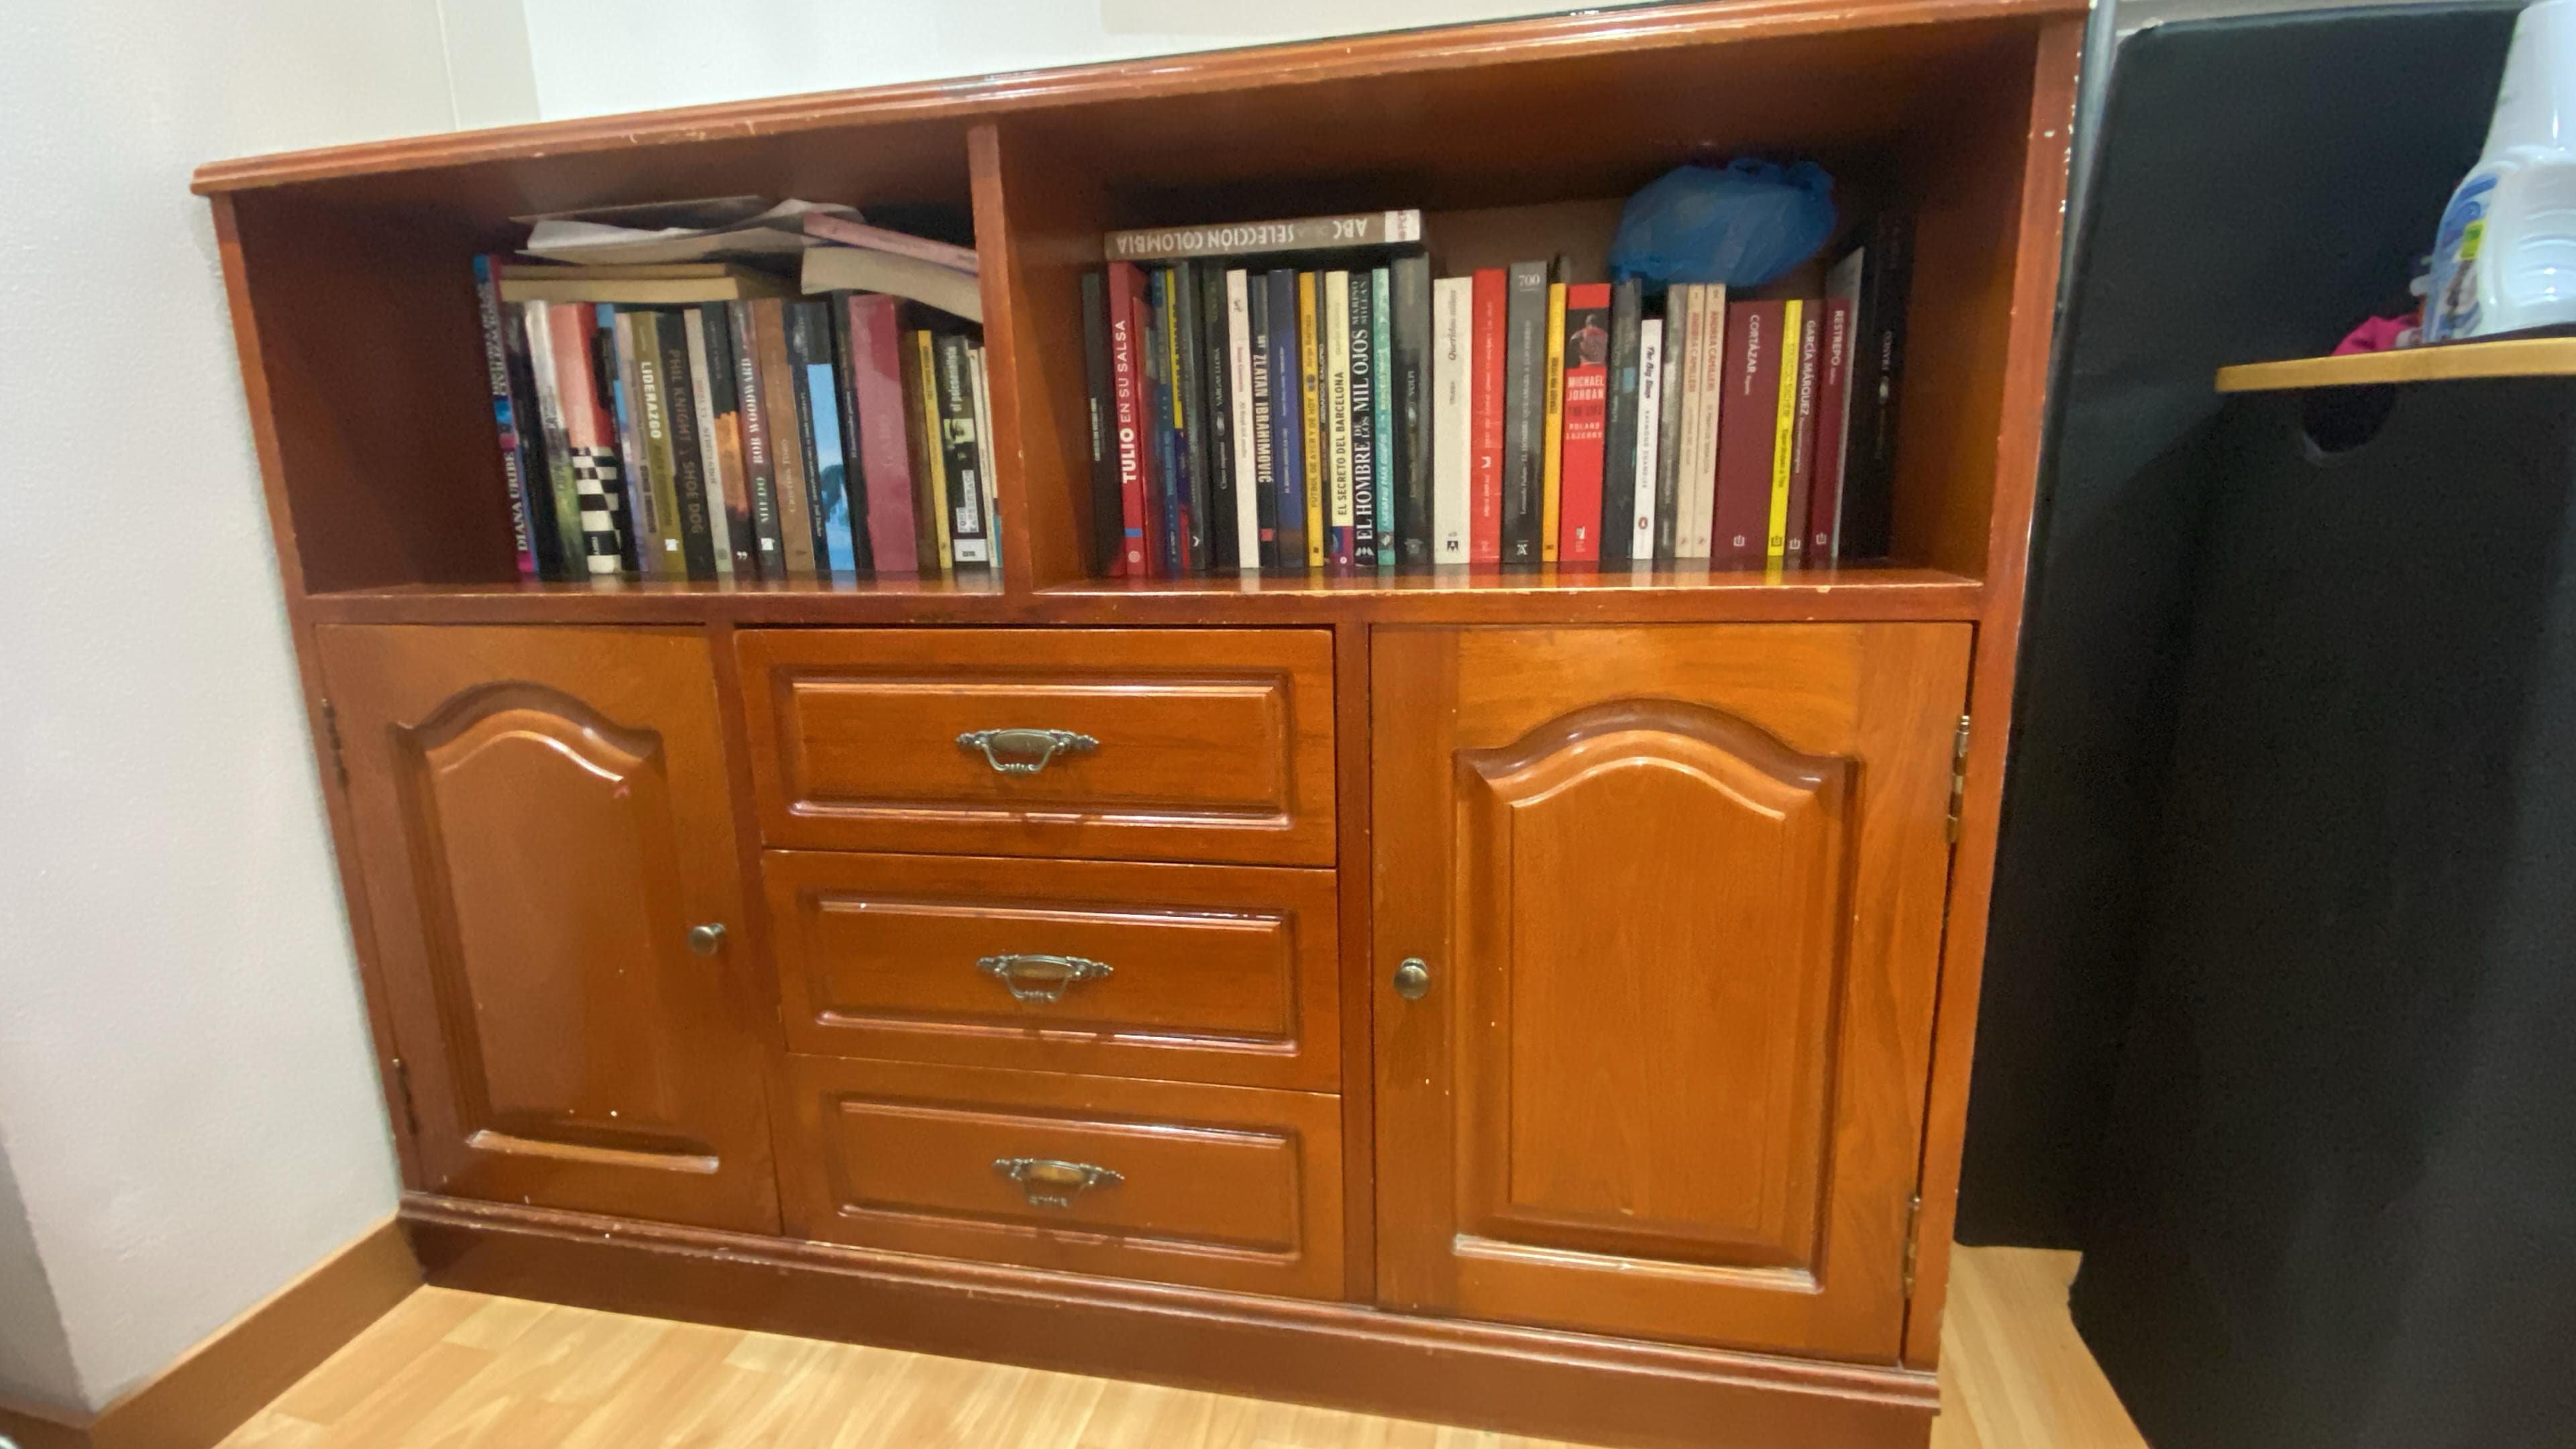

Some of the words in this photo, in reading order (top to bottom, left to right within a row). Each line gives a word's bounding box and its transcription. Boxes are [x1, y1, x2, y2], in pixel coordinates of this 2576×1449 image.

[1116, 231, 1203, 254] COLOMBIA
[1208, 223, 1294, 251] SELECCIÓN
[1333, 218, 1367, 239] ABC
[1519, 274, 1540, 286] 700
[1116, 320, 1128, 372] SALSA
[1690, 311, 1699, 347] ANDREA
[1709, 311, 1719, 346] ANDREA
[1747, 314, 1761, 373] CORTÁZAR
[1803, 320, 1816, 362] GARCÍA
[1830, 309, 1845, 366] RESTREPO
[668, 349, 684, 383] PHIL
[1352, 329, 1369, 375] OJOS
[1644, 362, 1654, 378] Big
[1647, 346, 1655, 361] The
[1688, 349, 1699, 393] CAMILLERI
[1706, 347, 1717, 392] CAMILLERI
[946, 346, 963, 401] psicoanalista
[1118, 378, 1130, 398] SU
[1252, 354, 1269, 397] ZLATAN
[1568, 374, 1605, 388] MICHAEL
[1799, 362, 1815, 416] MÁRQUEZ
[641, 361, 662, 439] LIDERAZGO
[674, 386, 692, 441] KNIGHT
[741, 358, 761, 433] WOODWARD
[1120, 403, 1130, 423] EN
[1334, 372, 1345, 433] BARCELONA
[1352, 378, 1370, 412] MIL
[1567, 388, 1605, 401] JORDAN
[1255, 402, 1274, 483] IBRAHIMOVIĆ
[1335, 435, 1346, 454] DEL
[1361, 415, 1371, 438] LOS
[750, 437, 764, 464] BOB
[1120, 427, 1136, 484] TULIO
[504, 451, 520, 498] URIBE
[682, 460, 700, 499] SHOE
[1336, 458, 1347, 500] SECRETO
[1353, 441, 1373, 515] HOMBRE
[688, 504, 704, 534] DOG
[755, 477, 769, 523] MIEDO
[1338, 500, 1348, 516] EL
[511, 501, 528, 551] DIANA
[1356, 519, 1373, 540] EL
